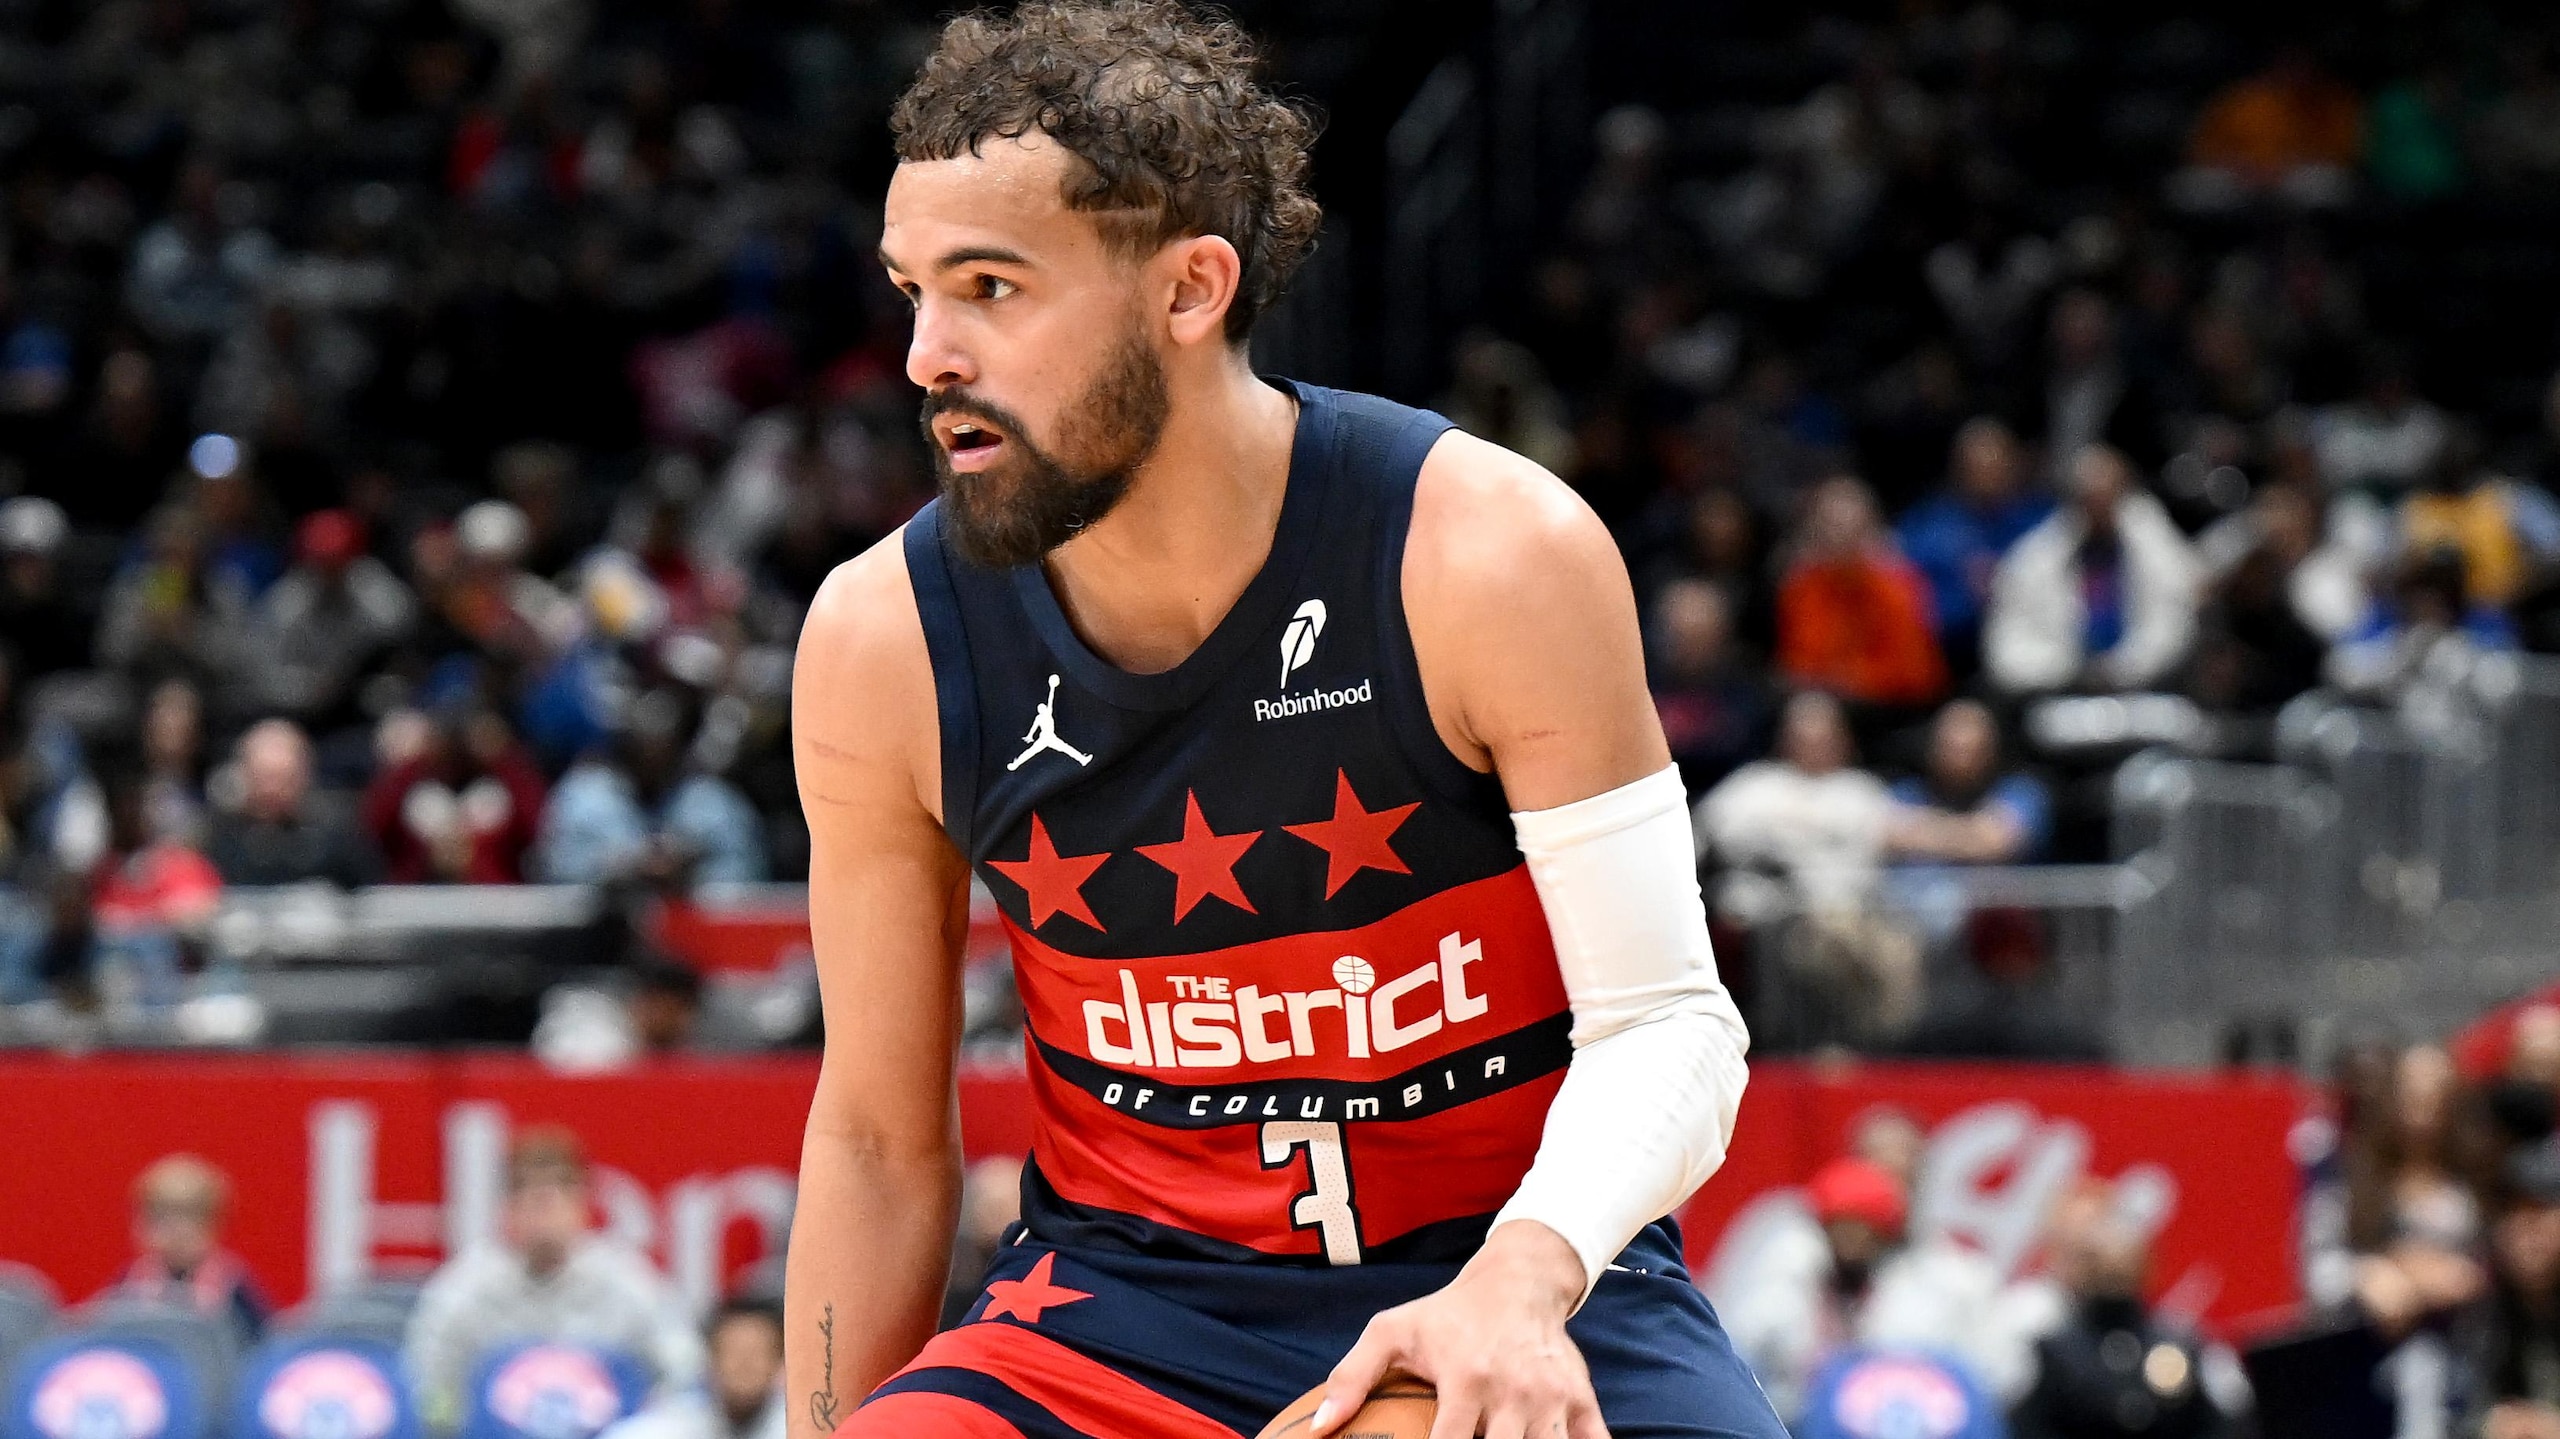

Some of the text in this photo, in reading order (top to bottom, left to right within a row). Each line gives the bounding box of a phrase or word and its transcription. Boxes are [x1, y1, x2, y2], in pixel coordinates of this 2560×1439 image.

[1253, 677, 1373, 722] Robinhood
[1082, 931, 1490, 1068] district
[1165, 975, 1234, 1001] THE
[1102, 1055, 1507, 1120] OF COLUMBIA
[1260, 1120, 1362, 1266] 3
